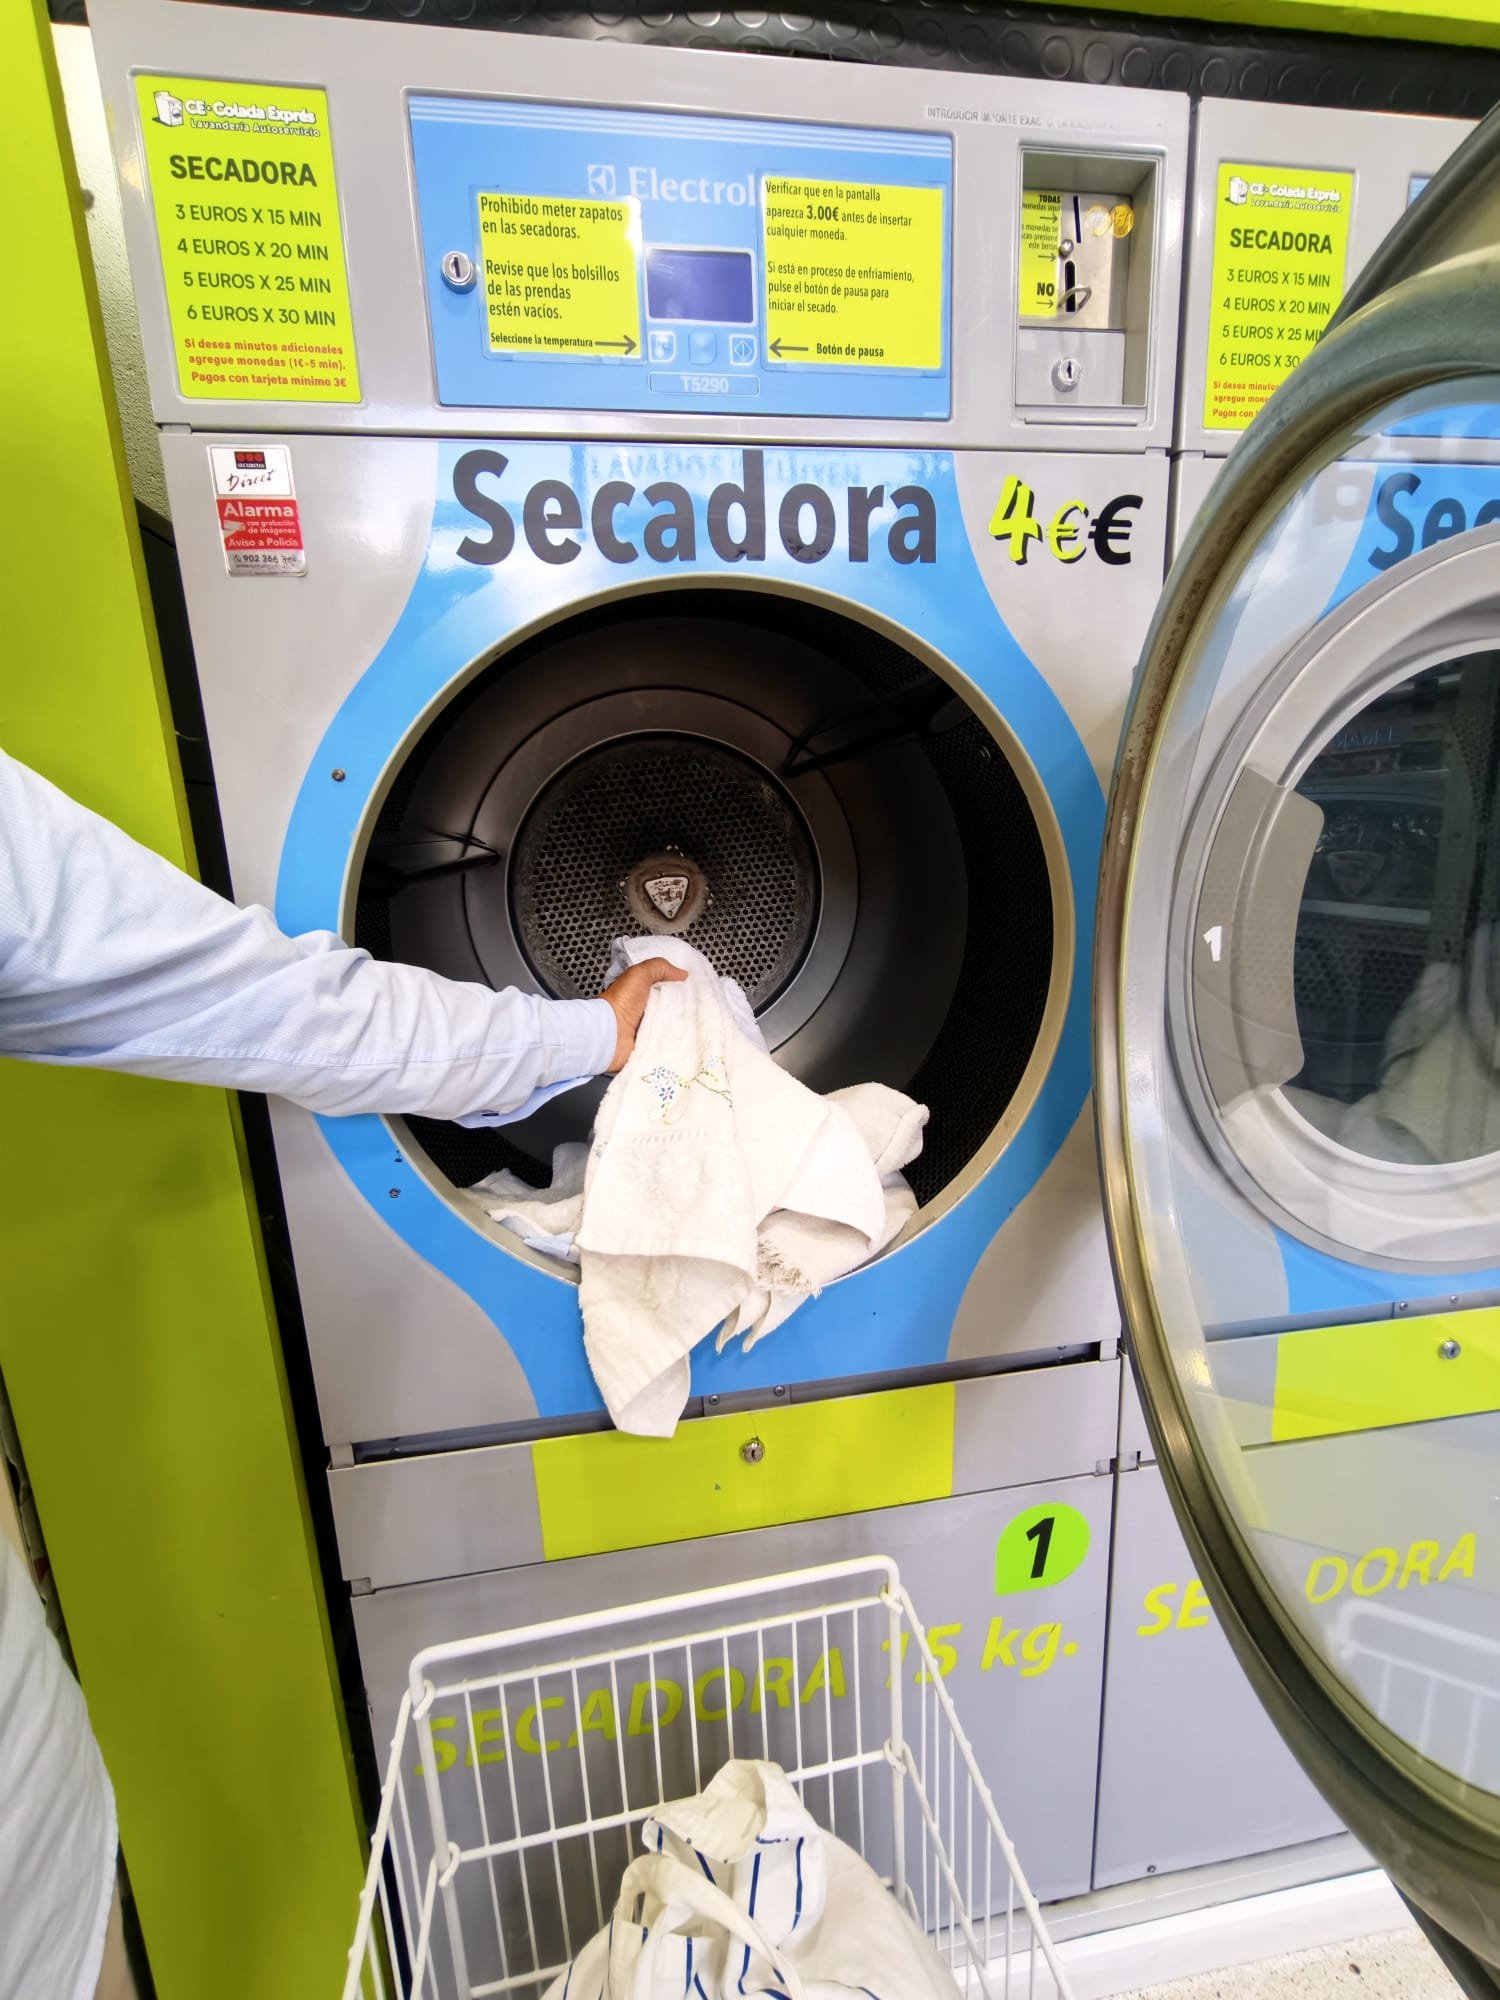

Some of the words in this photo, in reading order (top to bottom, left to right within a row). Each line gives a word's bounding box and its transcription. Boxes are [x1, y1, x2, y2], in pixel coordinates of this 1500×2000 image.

[253, 124, 321, 137] Autoservicio
[170, 155, 317, 187] SECADORA
[627, 166, 757, 207] Electrol
[765, 181, 802, 196] Verificar
[803, 186, 821, 200] que
[823, 187, 834, 198] en
[835, 185, 844, 199] la
[845, 186, 881, 202] pantalla
[1039, 194, 1060, 204] TODAS
[175, 204, 186, 220] 3
[190, 205, 247, 223] EUROS
[252, 209, 264, 223] X
[267, 209, 285, 225] 15
[290, 211, 322, 227] MIN
[480, 197, 539, 216] Prohibido
[542, 202, 576, 217] meter
[579, 206, 623, 223] zapatos
[766, 207, 804, 222] aparezca
[806, 205, 840, 222] 3.00€
[841, 212, 865, 224] antes
[867, 211, 878, 225] de
[879, 214, 912, 227] insertar
[482, 222, 497, 234] en
[501, 219, 517, 235] las
[521, 222, 580, 239] secadoras.
[766, 226, 808, 241] cualquier
[810, 228, 847, 241] moneda.
[177, 238, 188, 254] 4
[193, 239, 249, 256] EUROS
[255, 242, 266, 257] X
[270, 243, 292, 258] 20
[297, 245, 329, 261] MIN
[1229, 227, 1333, 255] SECADORA
[486, 260, 524, 276] Revise
[527, 264, 549, 281] que
[552, 262, 569, 279] los
[572, 264, 620, 282] bolsillos
[768, 260, 776, 273] Si
[778, 261, 795, 274] está
[797, 265, 808, 275] en
[810, 265, 843, 279] proceso
[845, 265, 856, 278] de
[858, 266, 915, 283] enfriamiento,
[1227, 269, 1235, 282] 3
[1238, 269, 1278, 284] EUROS
[1281, 272, 1290, 285] X
[1293, 272, 1305, 286] 15
[1308, 274, 1330, 288] MIN
[183, 272, 193, 287] 5
[198, 272, 255, 290] EUROS
[260, 275, 271, 290] X
[275, 276, 296, 292] 25
[300, 278, 331, 293] MIN
[487, 280, 502, 296] de
[505, 281, 522, 297] las
[525, 282, 571, 300] prendas
[768, 280, 792, 295] pulse
[793, 282, 802, 293] el
[804, 282, 829, 295] botón
[831, 284, 842, 296] de
[843, 287, 869, 299] pausa
[870, 287, 889, 299] para
[1037, 282, 1055, 297] NO
[489, 302, 521, 316] estén
[524, 302, 562, 319] vacíos.
[768, 299, 795, 312] iniciar
[797, 301, 805, 312] el
[807, 301, 838, 314] secado.
[1223, 297, 1231, 310] 4
[1235, 297, 1275, 312] EUROS
[1278, 300, 1287, 313] X
[1289, 300, 1305, 314] 20
[1309, 302, 1330, 315] MIN
[187, 305, 197, 320] 6
[202, 305, 258, 323] EUROS
[263, 308, 275, 323] X
[278, 309, 299, 324] 30
[304, 310, 336, 326] MIN
[490, 332, 533, 344] Seleccione
[534, 334, 542, 345] la
[544, 336, 593, 348] temperatura
[1222, 325, 1230, 338] 5
[1233, 325, 1274, 340] EUROS
[1276, 328, 1284, 340] X
[1288, 328, 1302, 341] 25
[184, 338, 195, 348] Si
[198, 339, 231, 349] desea
[234, 341, 278, 352] minutos
[281, 343, 344, 355] adicionales
[816, 343, 843, 356] Botón
[845, 344, 856, 357] de
[858, 347, 884, 359] pausa
[189, 356, 234, 366] agregue
[237, 356, 286, 367] monedas
[1219, 353, 1227, 366] 6
[1231, 353, 1271, 367] EUROS
[1273, 355, 1281, 368] X
[1284, 355, 1300, 368] 30
[192, 372, 226, 384] Pagos
[229, 374, 249, 383] con
[251, 374, 288, 386] tarjeta
[333, 377, 347, 387] 3€
[680, 376, 730, 393] T5290
[1213, 381, 1221, 389] Si
[1222, 381, 1246, 390] desea
[1214, 395, 1246, 404] agregue
[1213, 408, 1237, 418] Pagos
[223, 501, 294, 517] Alarma
[452, 448, 937, 565] Secadora
[259, 527, 296, 535] imágenes
[229, 538, 256, 546] Aviso
[243, 554, 259, 563] 902
[1025, 1517, 1056, 1579] 1
[980, 1617, 1078, 1678] kg.
[414, 1648, 848, 1776] SECADORA
